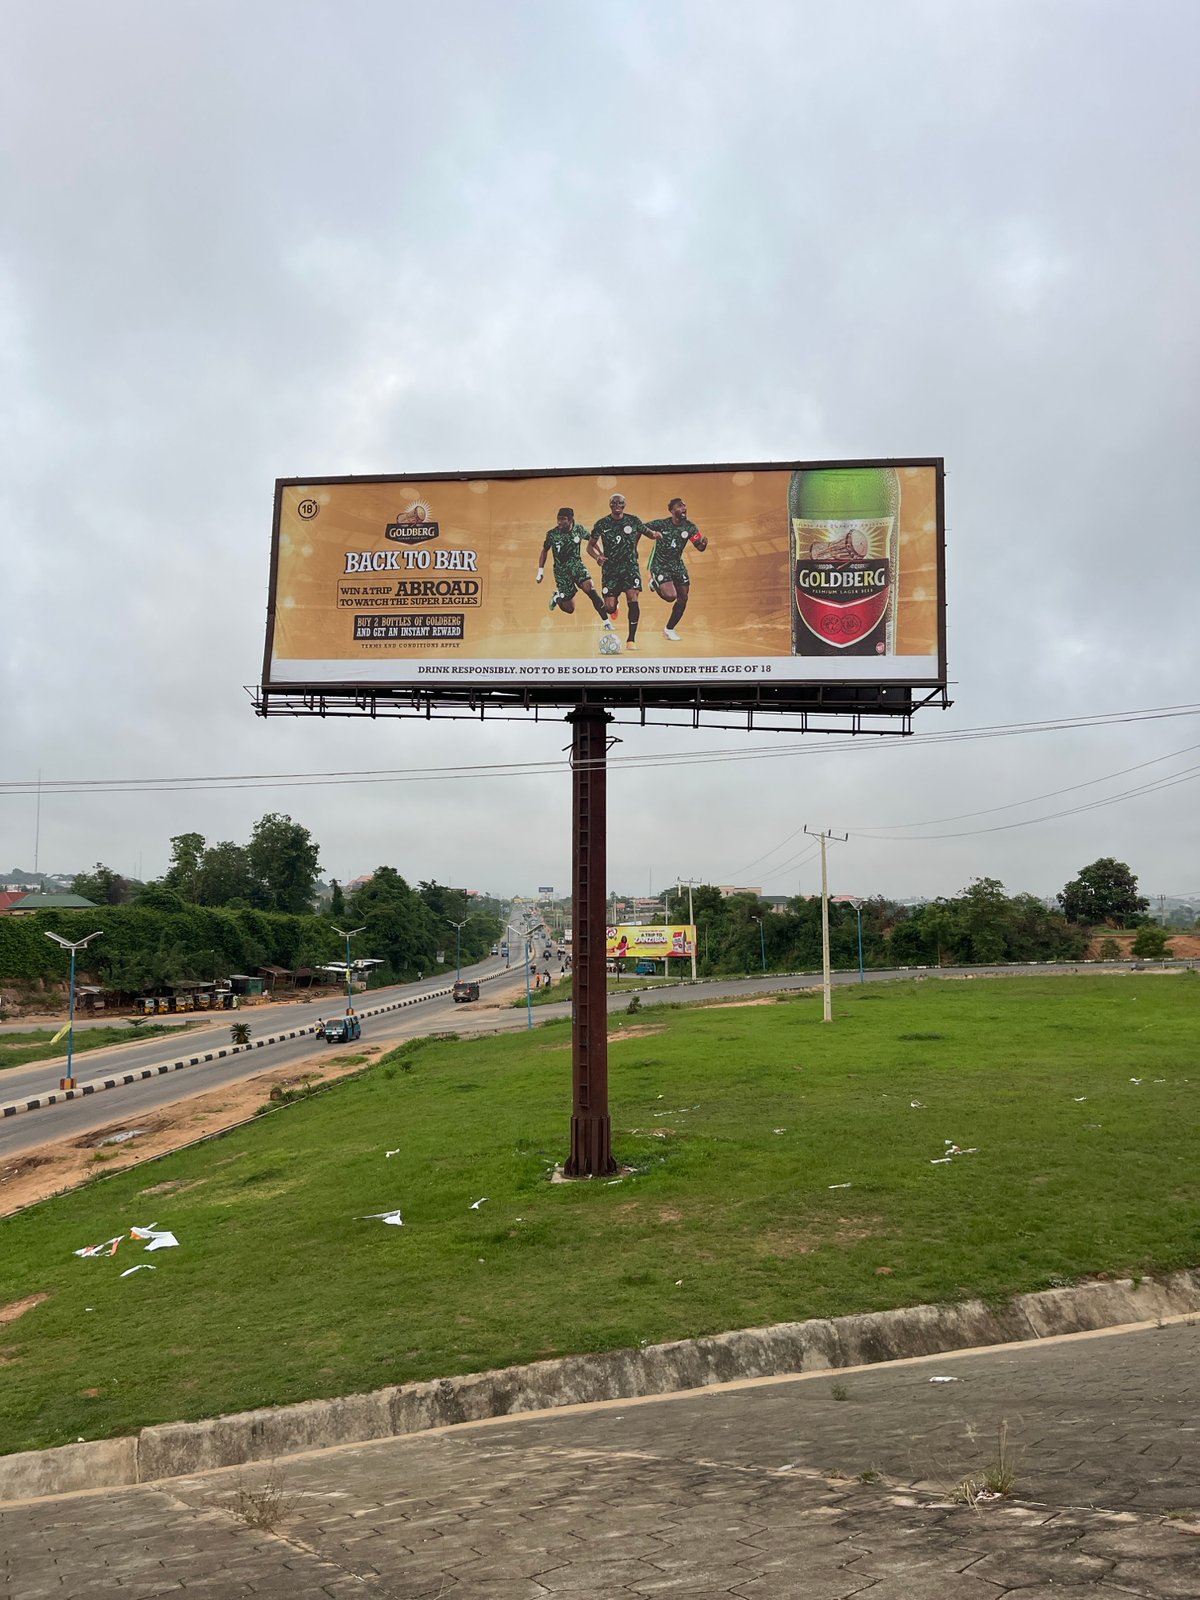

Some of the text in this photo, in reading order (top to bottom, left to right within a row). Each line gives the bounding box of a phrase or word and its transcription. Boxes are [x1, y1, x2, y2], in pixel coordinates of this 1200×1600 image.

[390, 527, 435, 538] GOLDBERG
[616, 535, 622, 544] 9
[670, 539, 677, 548] 4
[344, 550, 479, 574] BACK TO BAR
[634, 578, 640, 586] 9
[800, 568, 885, 587] GOLDBERG
[340, 587, 360, 595] WIN
[367, 587, 392, 595] TRIP
[395, 580, 479, 596] ABROAD
[353, 598, 391, 607] WATCH
[390, 598, 409, 606] THE
[410, 597, 440, 605] SUPER
[441, 596, 478, 605] EAGLES
[357, 616, 461, 627] BUY 2 BOTTLES OF GOLDBERG
[356, 627, 461, 637] AND GET AN INSTANT REWARD
[418, 666, 449, 674] DRINK
[519, 666, 541, 674] NOT
[541, 666, 555, 674] TO
[557, 666, 570, 674] BE
[572, 666, 598, 674] SOLD
[600, 666, 613, 674] TO
[616, 666, 660, 674] PERSONS
[662, 665, 699, 673] UNDER
[699, 665, 718, 673] THE
[720, 665, 742, 673] AGE
